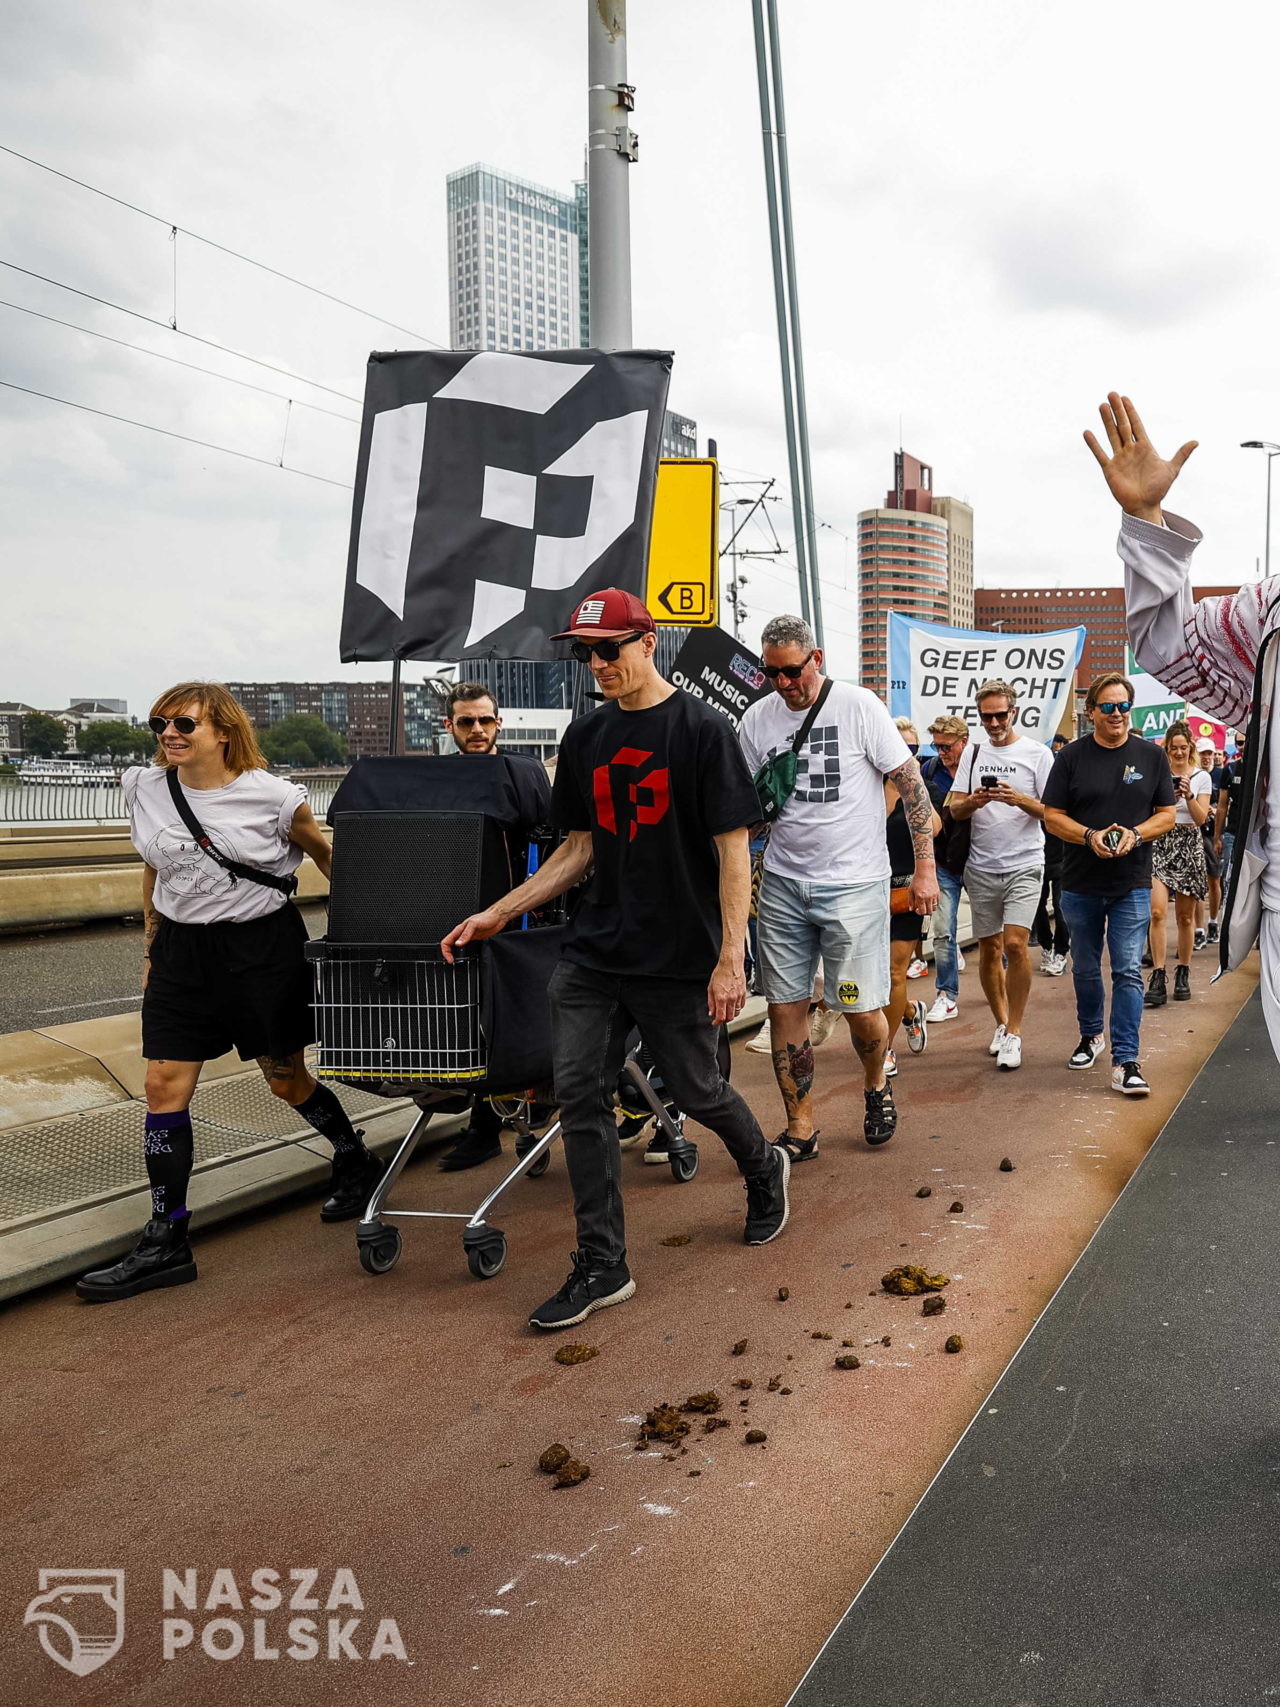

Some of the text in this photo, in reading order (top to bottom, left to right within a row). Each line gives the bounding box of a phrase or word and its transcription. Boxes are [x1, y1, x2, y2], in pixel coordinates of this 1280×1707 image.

[505, 183, 559, 215] Deloitte
[681, 424, 696, 440] akd
[679, 588, 694, 610] B
[920, 648, 1066, 670] GEEF ONS
[700, 665, 749, 710] MUSIC
[921, 676, 1066, 700] DE NCHT
[979, 765, 1016, 773] DENHAM
